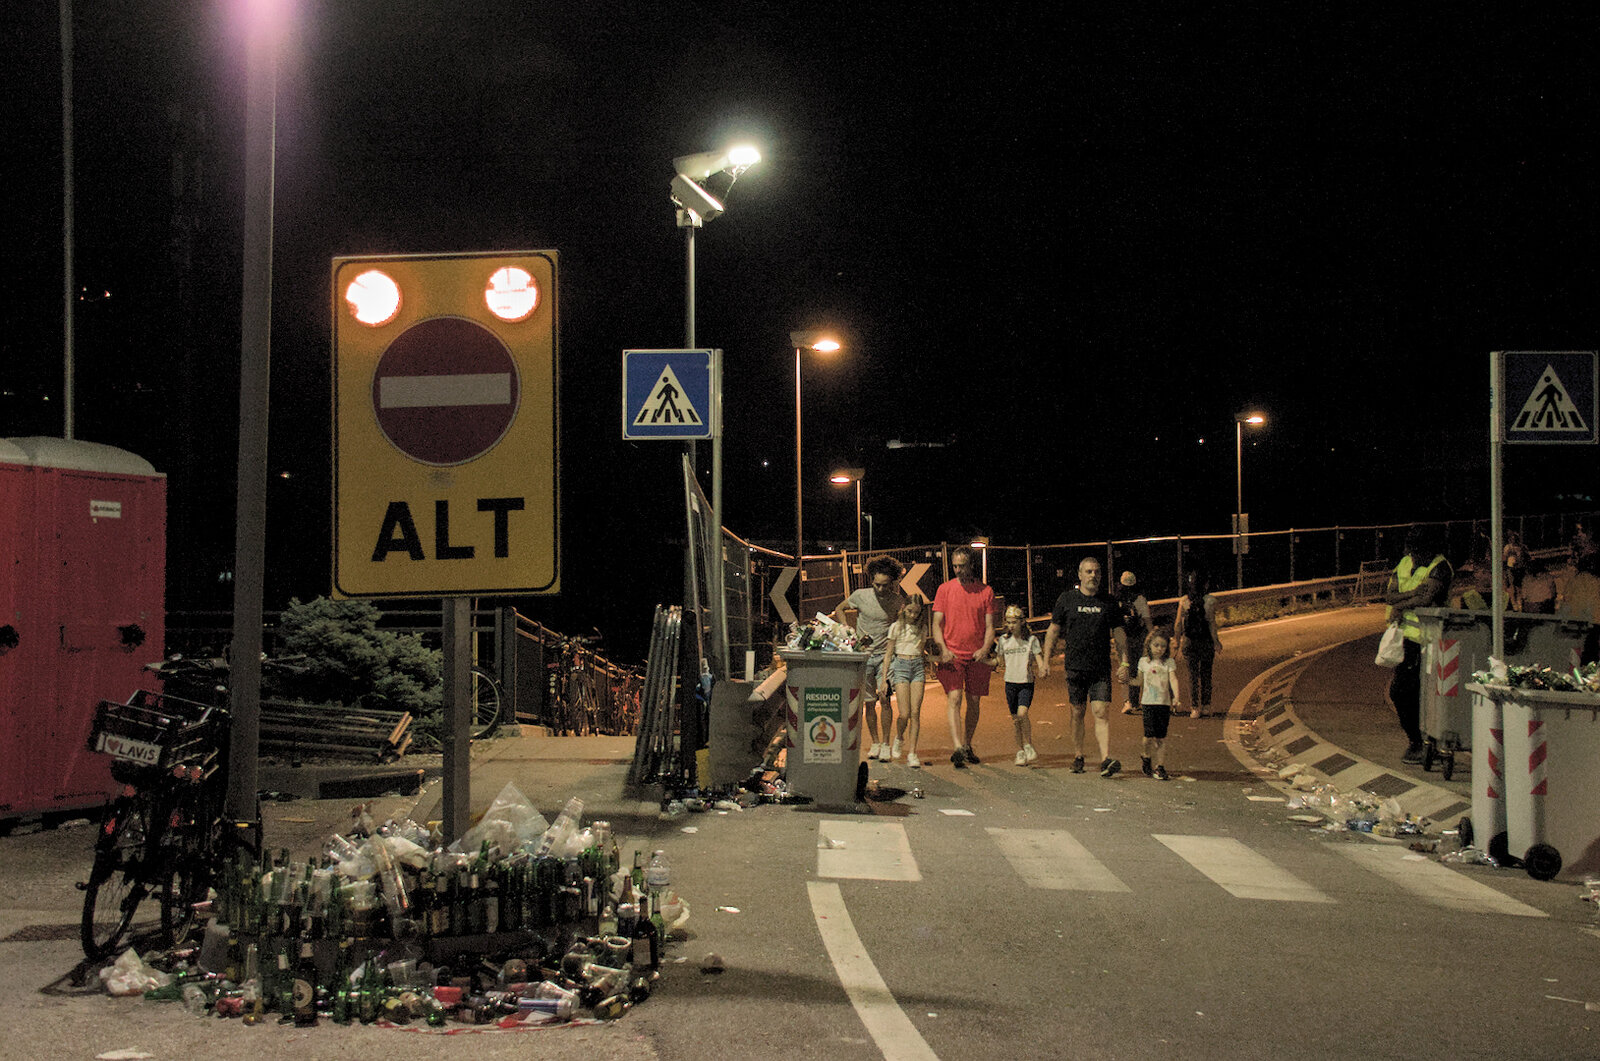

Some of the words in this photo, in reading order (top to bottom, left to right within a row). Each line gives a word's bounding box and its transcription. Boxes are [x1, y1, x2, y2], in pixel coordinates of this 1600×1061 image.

[371, 497, 525, 562] ALT
[805, 693, 840, 701] RESIDUO
[119, 743, 155, 760] LAVIS
